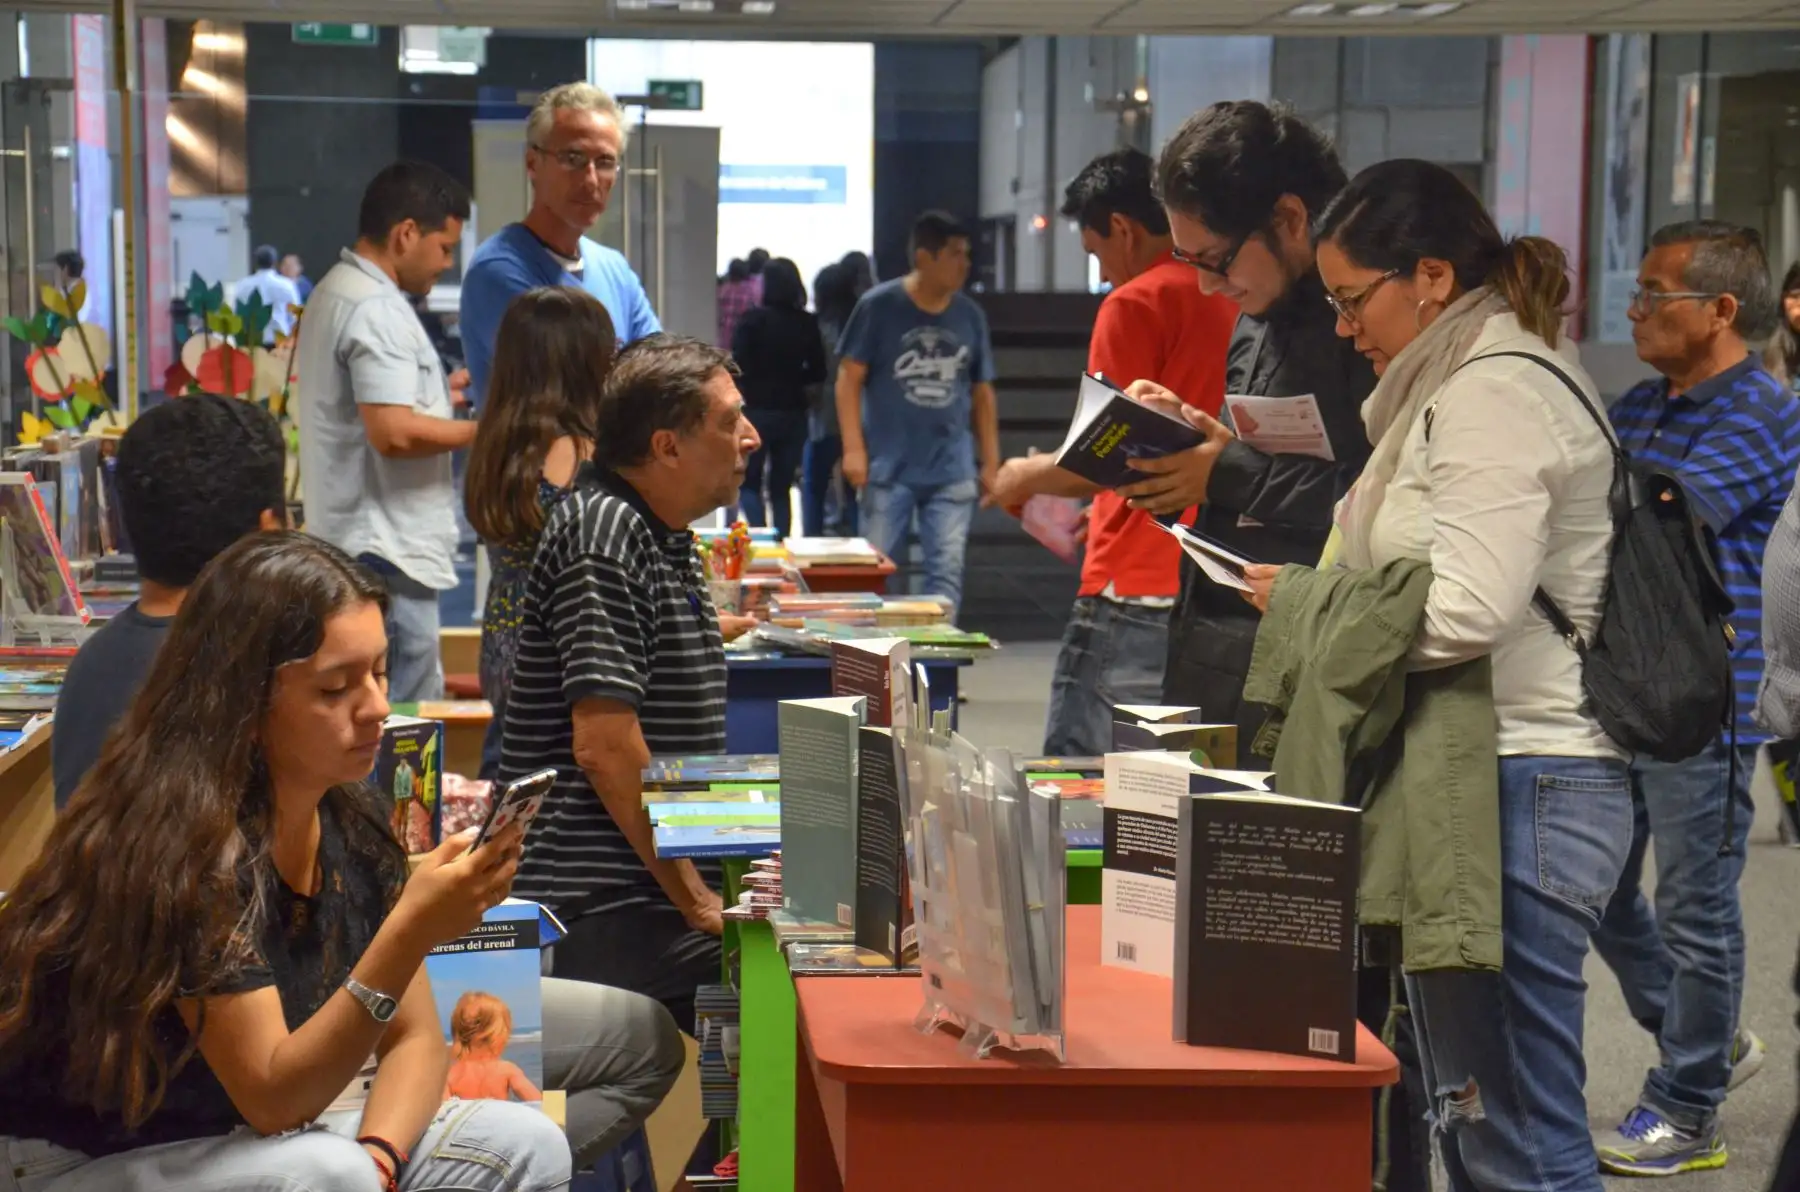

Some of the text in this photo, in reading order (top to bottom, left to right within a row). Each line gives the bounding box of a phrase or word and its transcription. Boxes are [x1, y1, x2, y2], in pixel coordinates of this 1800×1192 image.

[488, 924, 515, 933] DÁVILA
[467, 940, 482, 950] del
[483, 938, 515, 949] arenal
